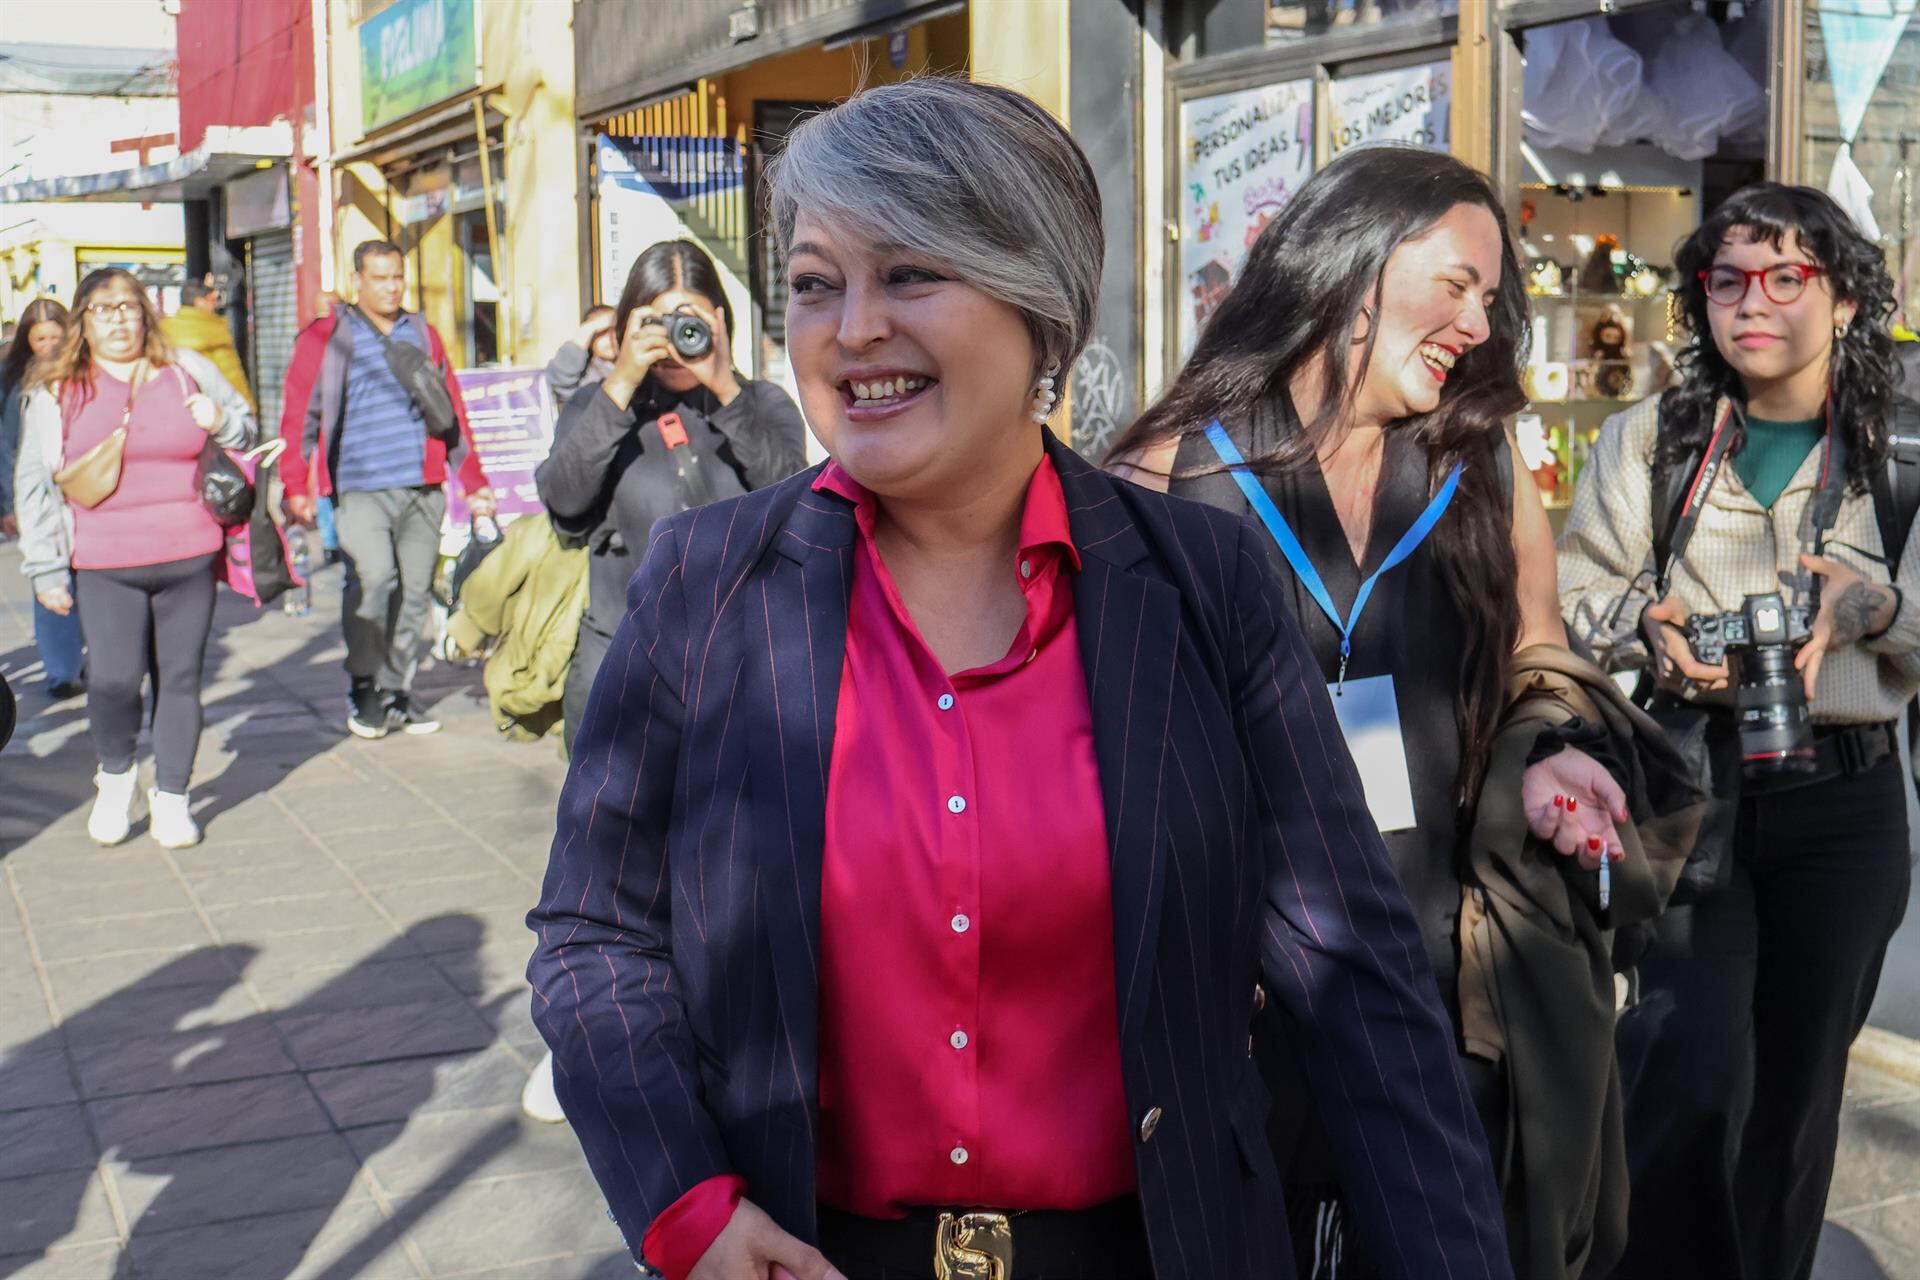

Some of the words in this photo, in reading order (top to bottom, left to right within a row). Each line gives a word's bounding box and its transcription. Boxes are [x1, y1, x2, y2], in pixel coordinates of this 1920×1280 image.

[1193, 84, 1297, 161] PERSONALIZA
[1331, 119, 1362, 152] LOS
[1214, 158, 1242, 189] TUS
[1244, 130, 1289, 171] IDEAS
